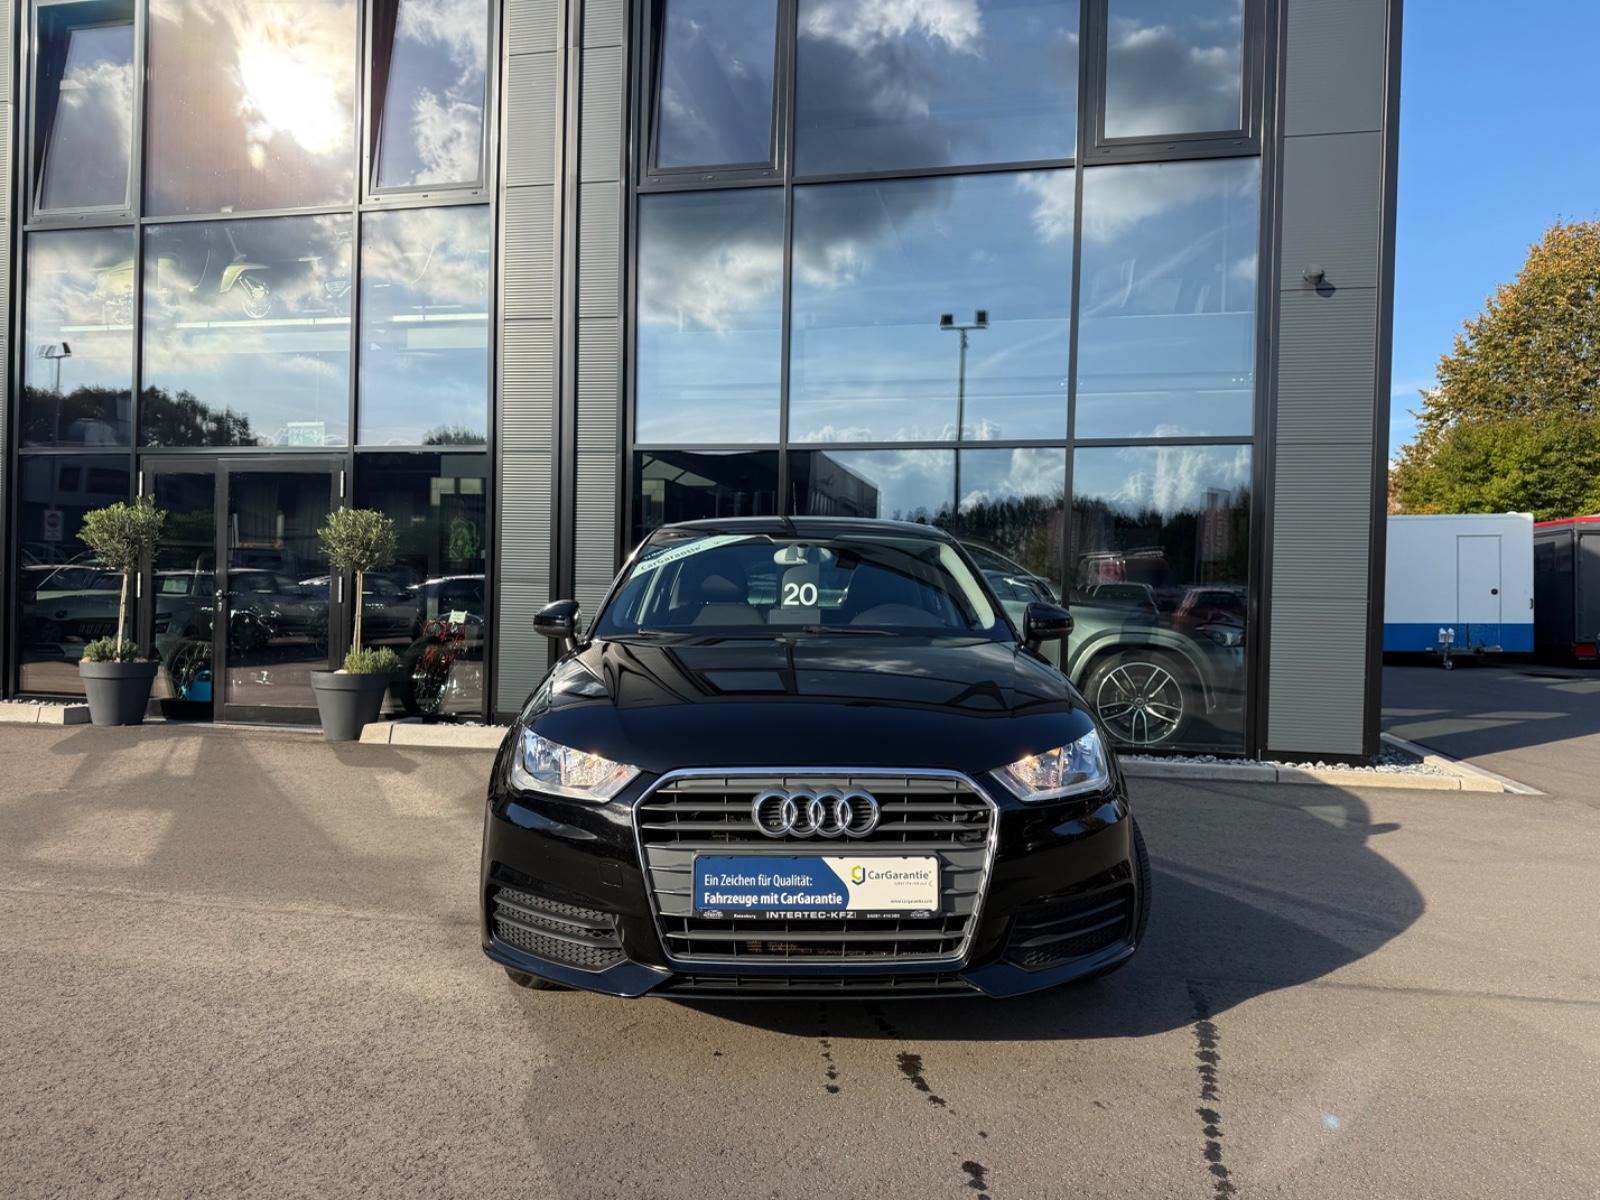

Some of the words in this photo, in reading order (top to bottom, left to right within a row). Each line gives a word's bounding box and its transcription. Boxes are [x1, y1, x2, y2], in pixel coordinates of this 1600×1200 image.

[783, 582, 818, 606] 20
[704, 874, 719, 886] Ein
[720, 874, 756, 886] Zeichen
[757, 874, 771, 886] für
[773, 874, 813, 887] Qualität:
[867, 870, 929, 880] CarGarantie
[704, 892, 758, 907] Fahrzeuge
[760, 892, 779, 904] mit
[780, 892, 842, 904] CarGarantie
